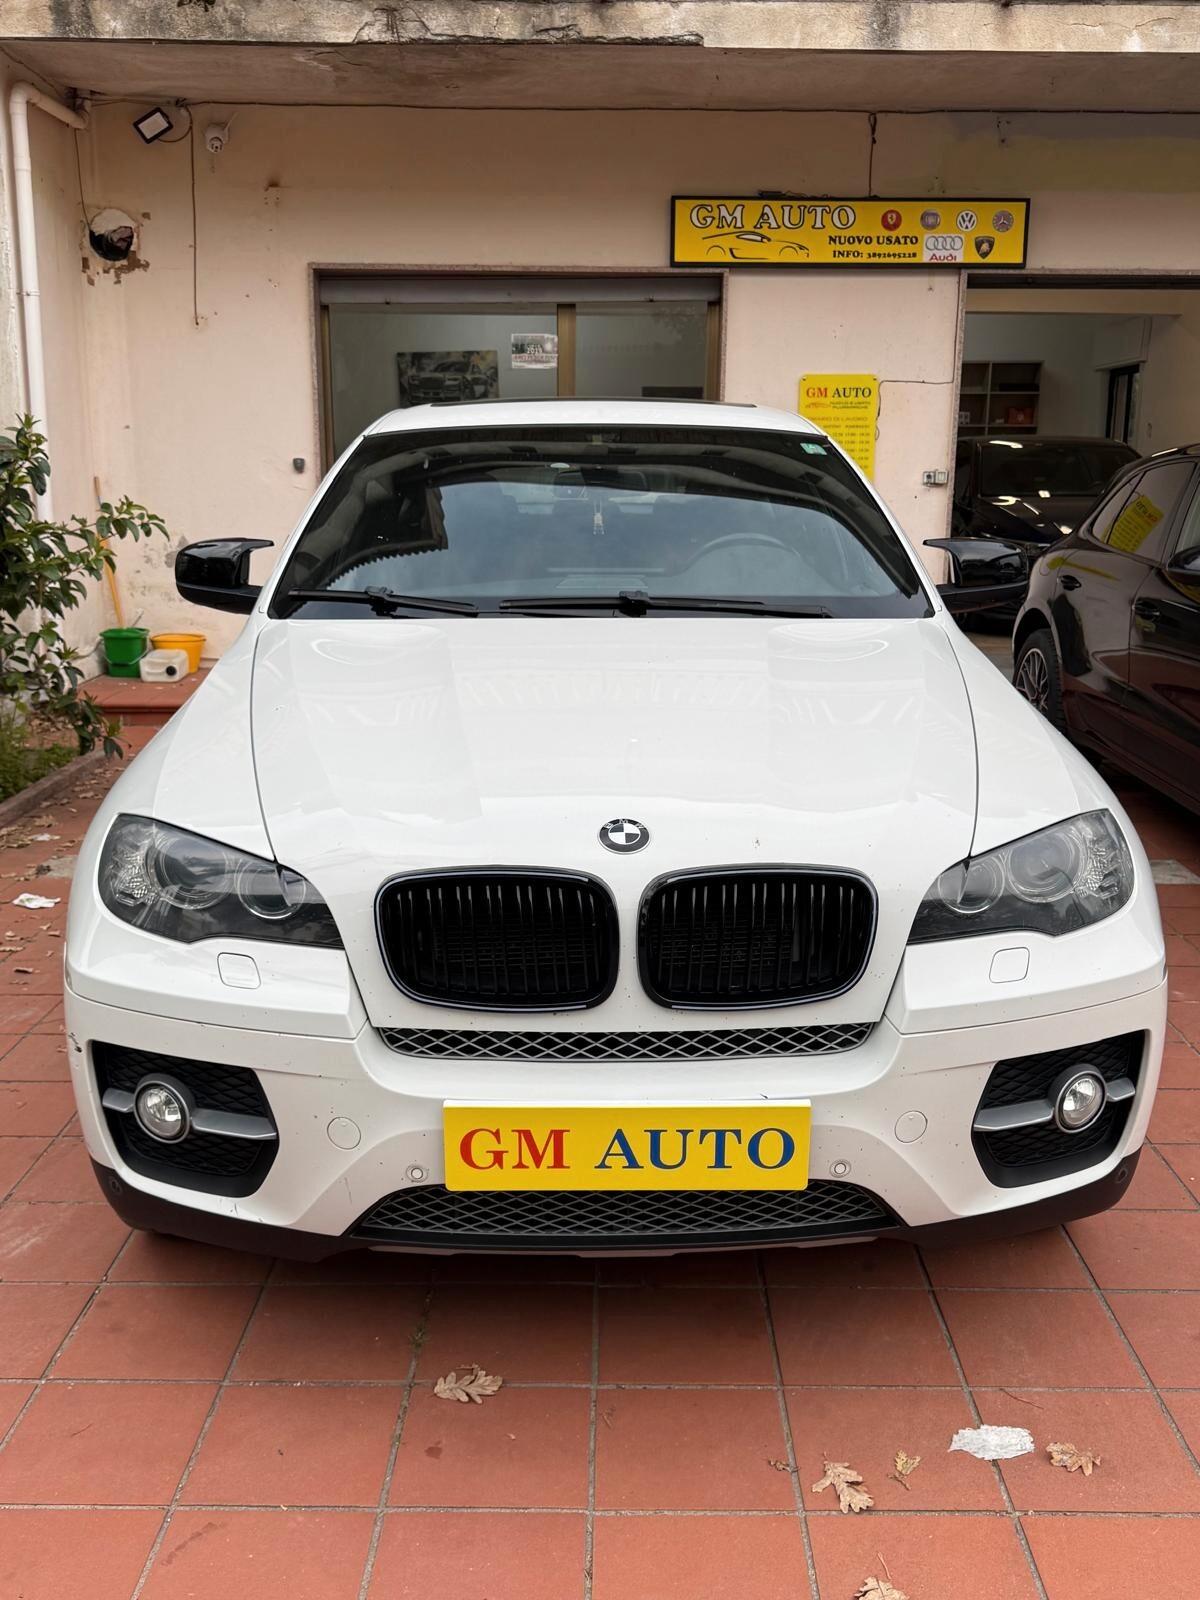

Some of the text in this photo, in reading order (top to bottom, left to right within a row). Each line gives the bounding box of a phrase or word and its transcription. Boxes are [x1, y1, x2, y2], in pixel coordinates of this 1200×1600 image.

[690, 204, 857, 229] GM AUTO
[828, 235, 919, 246] NUOVO USATO
[832, 250, 864, 259] INFO:
[929, 253, 957, 262] Audi
[806, 387, 872, 399] GM AUTO
[459, 1127, 796, 1170] GM AUTO
